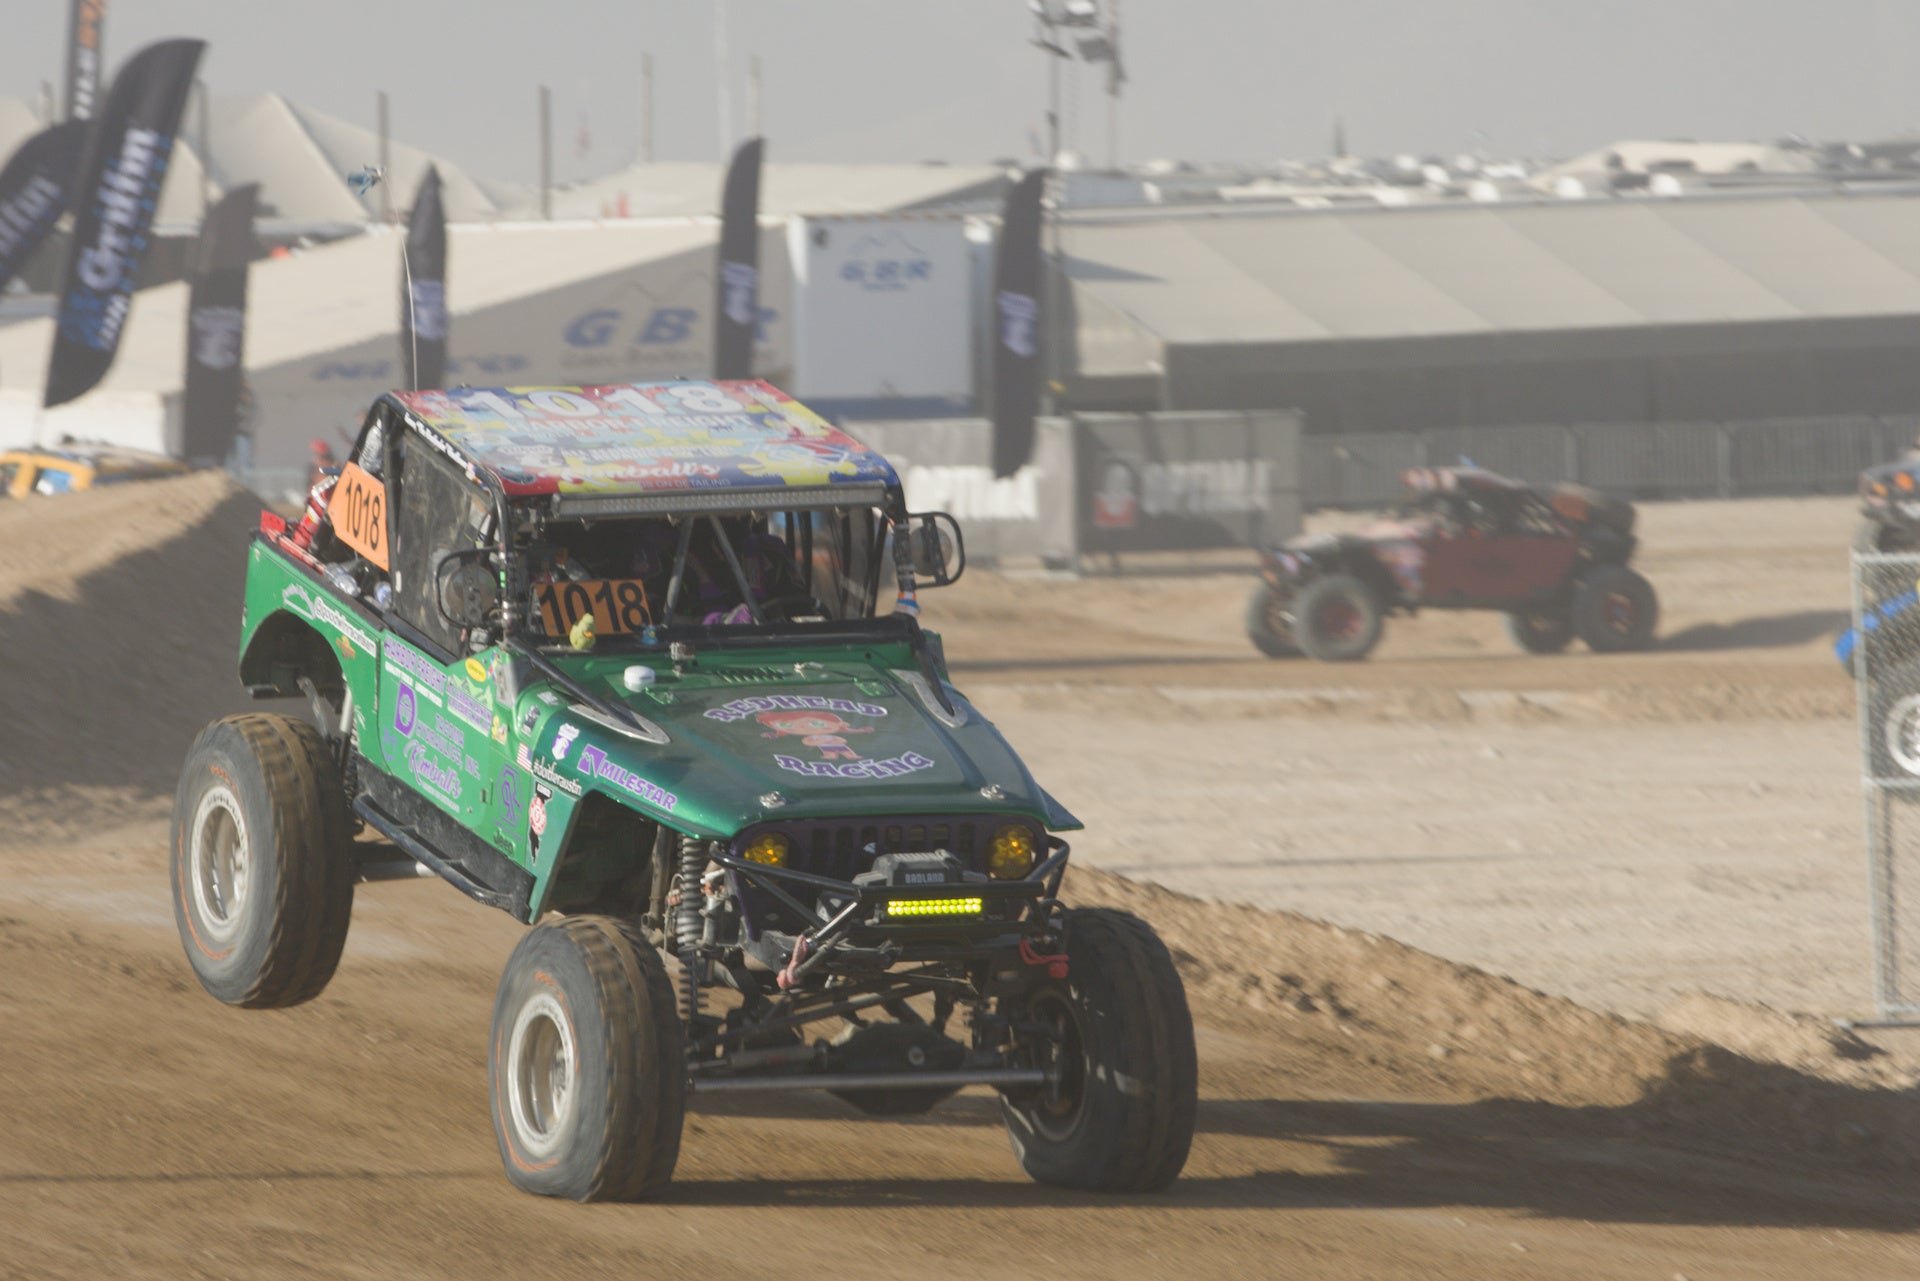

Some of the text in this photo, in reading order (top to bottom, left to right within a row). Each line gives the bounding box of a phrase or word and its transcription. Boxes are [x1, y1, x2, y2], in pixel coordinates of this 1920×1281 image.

[460, 384, 745, 419] 1018
[345, 477, 381, 552] 1018
[540, 579, 650, 634] 1018
[383, 634, 417, 676] HARBOR
[415, 655, 448, 697] FREIGHT
[435, 712, 465, 750] TACOMA
[703, 695, 888, 722] REDHEAD
[403, 739, 463, 799] Kimball's
[599, 759, 678, 812] MILESTAR
